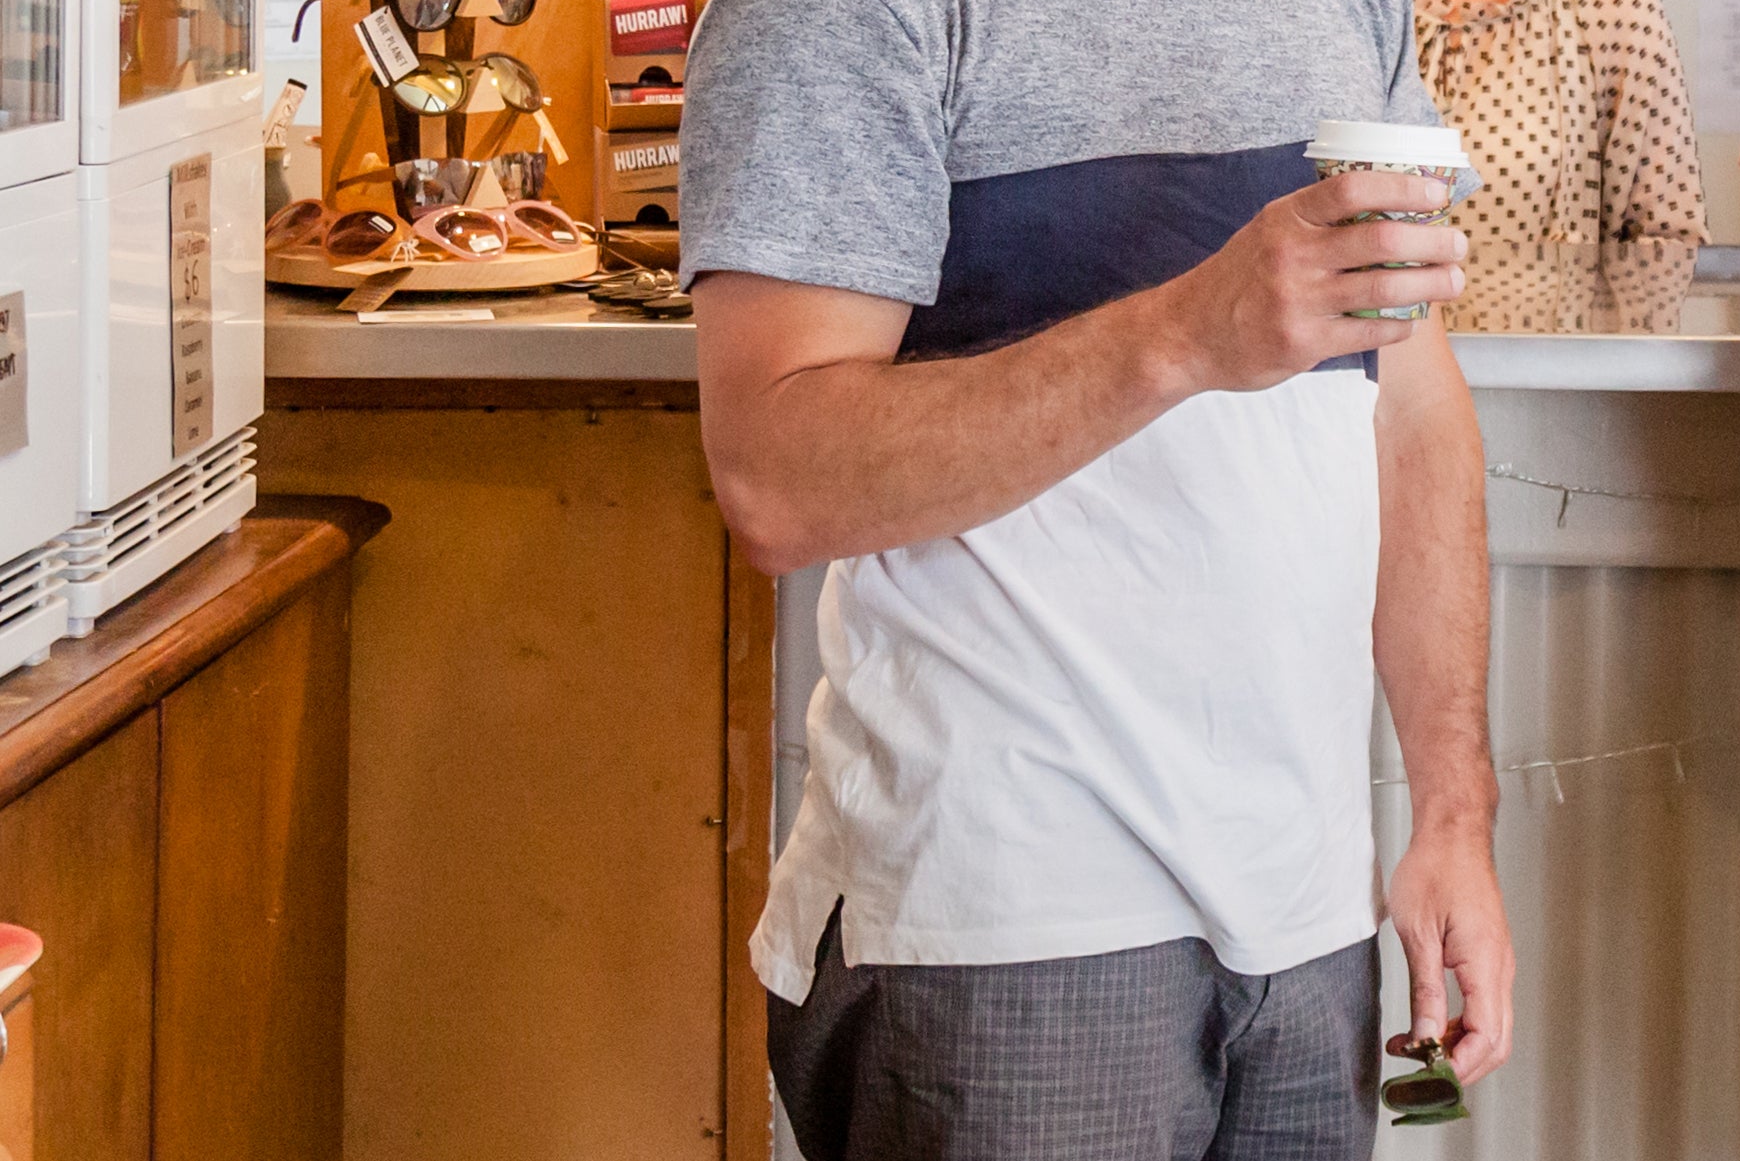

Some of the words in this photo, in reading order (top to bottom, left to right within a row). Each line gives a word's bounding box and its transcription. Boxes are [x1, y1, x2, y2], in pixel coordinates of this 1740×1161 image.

[374, 14, 391, 36] BLUE
[385, 35, 408, 68] PLANET
[615, 4, 688, 34] HURRAW!
[184, 259, 200, 304] $6
